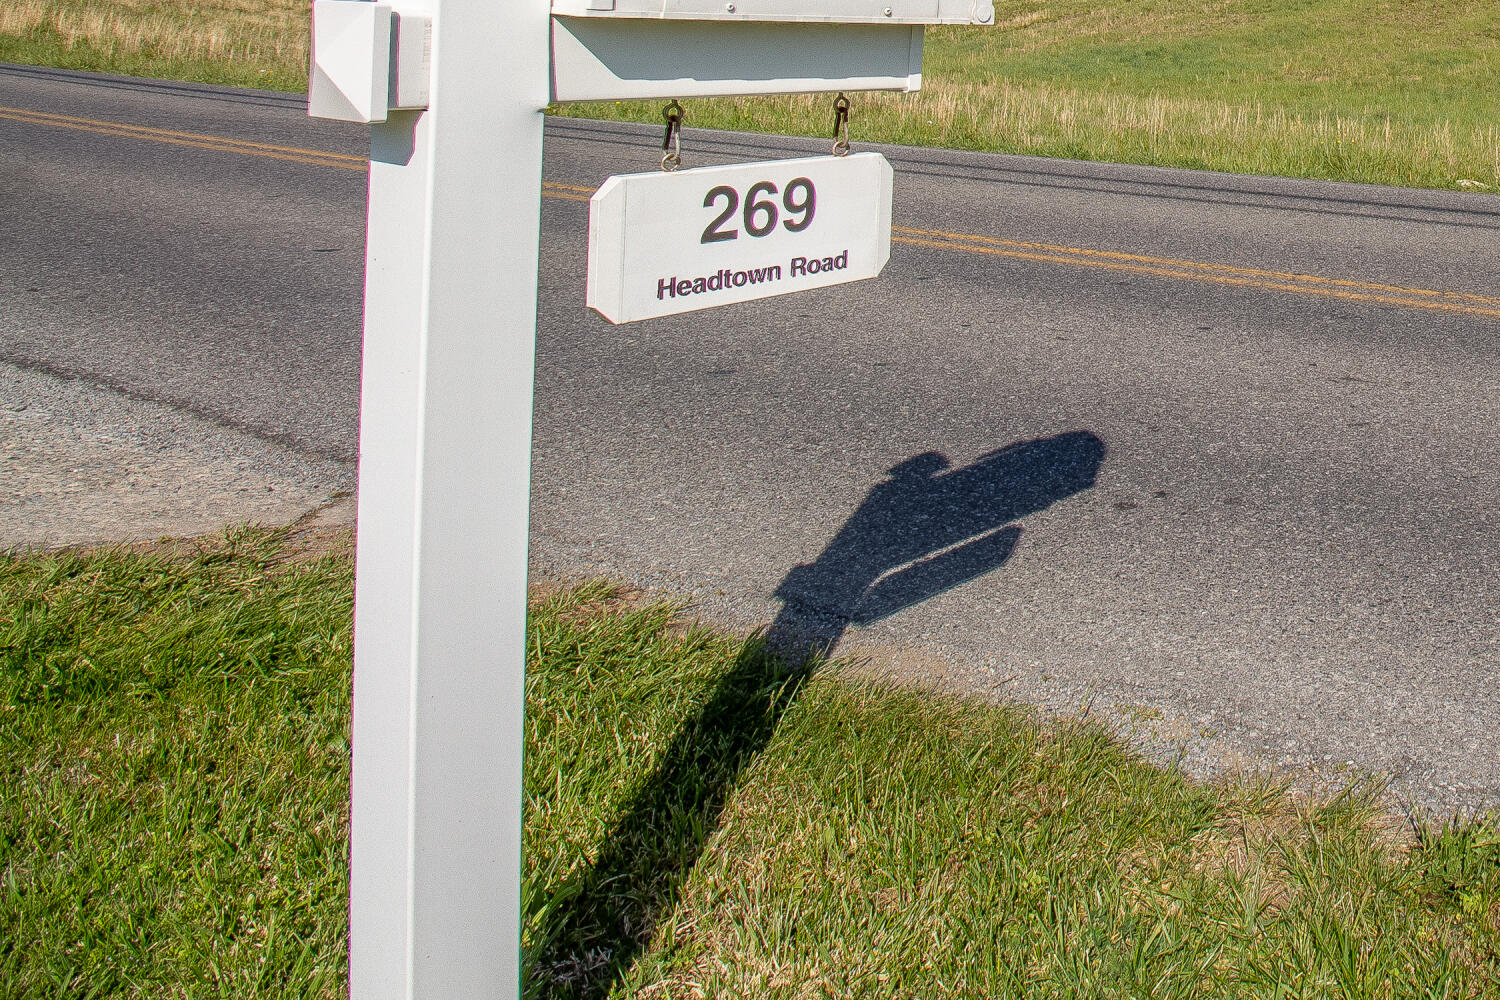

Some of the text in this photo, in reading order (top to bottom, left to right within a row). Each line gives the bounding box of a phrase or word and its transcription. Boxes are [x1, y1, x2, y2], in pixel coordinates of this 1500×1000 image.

[700, 177, 816, 244] 269
[656, 249, 849, 300] Headtown Road
